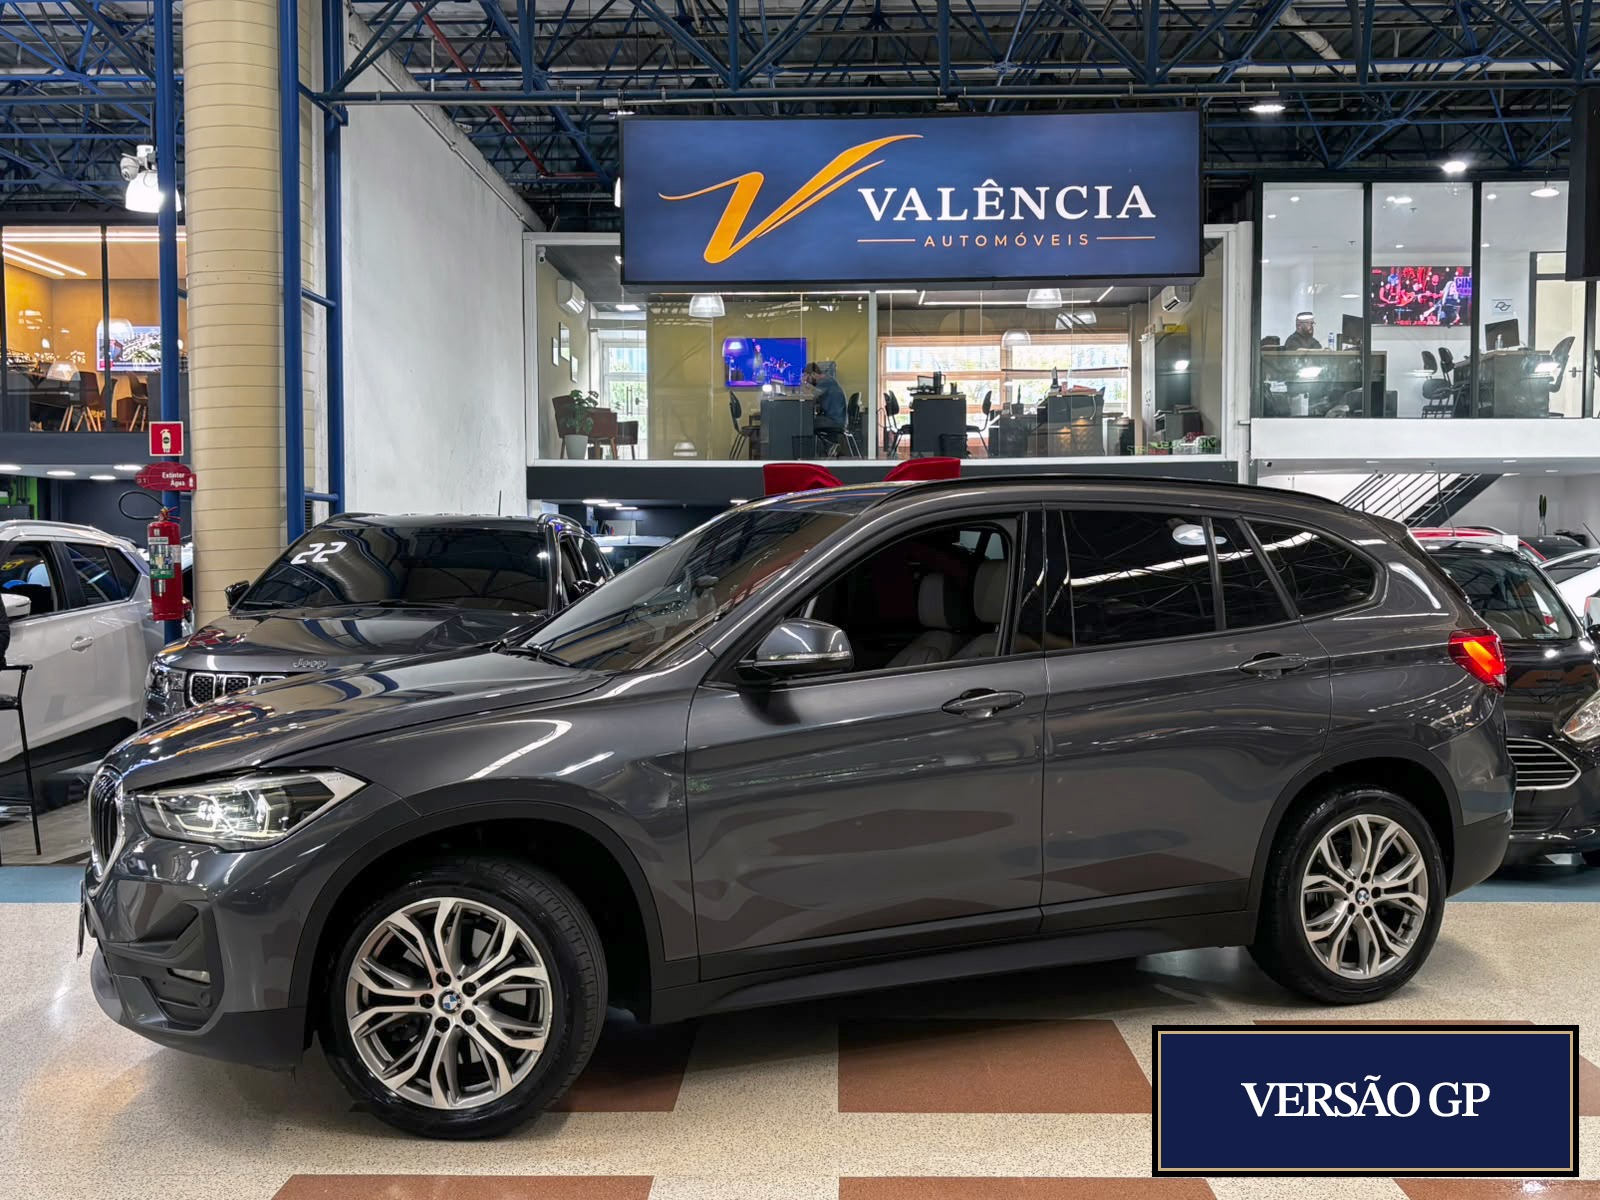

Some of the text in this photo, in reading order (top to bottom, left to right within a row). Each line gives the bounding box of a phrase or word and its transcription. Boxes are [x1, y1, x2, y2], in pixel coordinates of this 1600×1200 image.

[858, 178, 1156, 222] VALÊNCIA
[924, 231, 1089, 247] AUTOMÓVEIS
[161, 471, 185, 479] Extintor
[170, 478, 186, 488] Água
[290, 541, 348, 565] 22
[292, 657, 328, 670] Jeep
